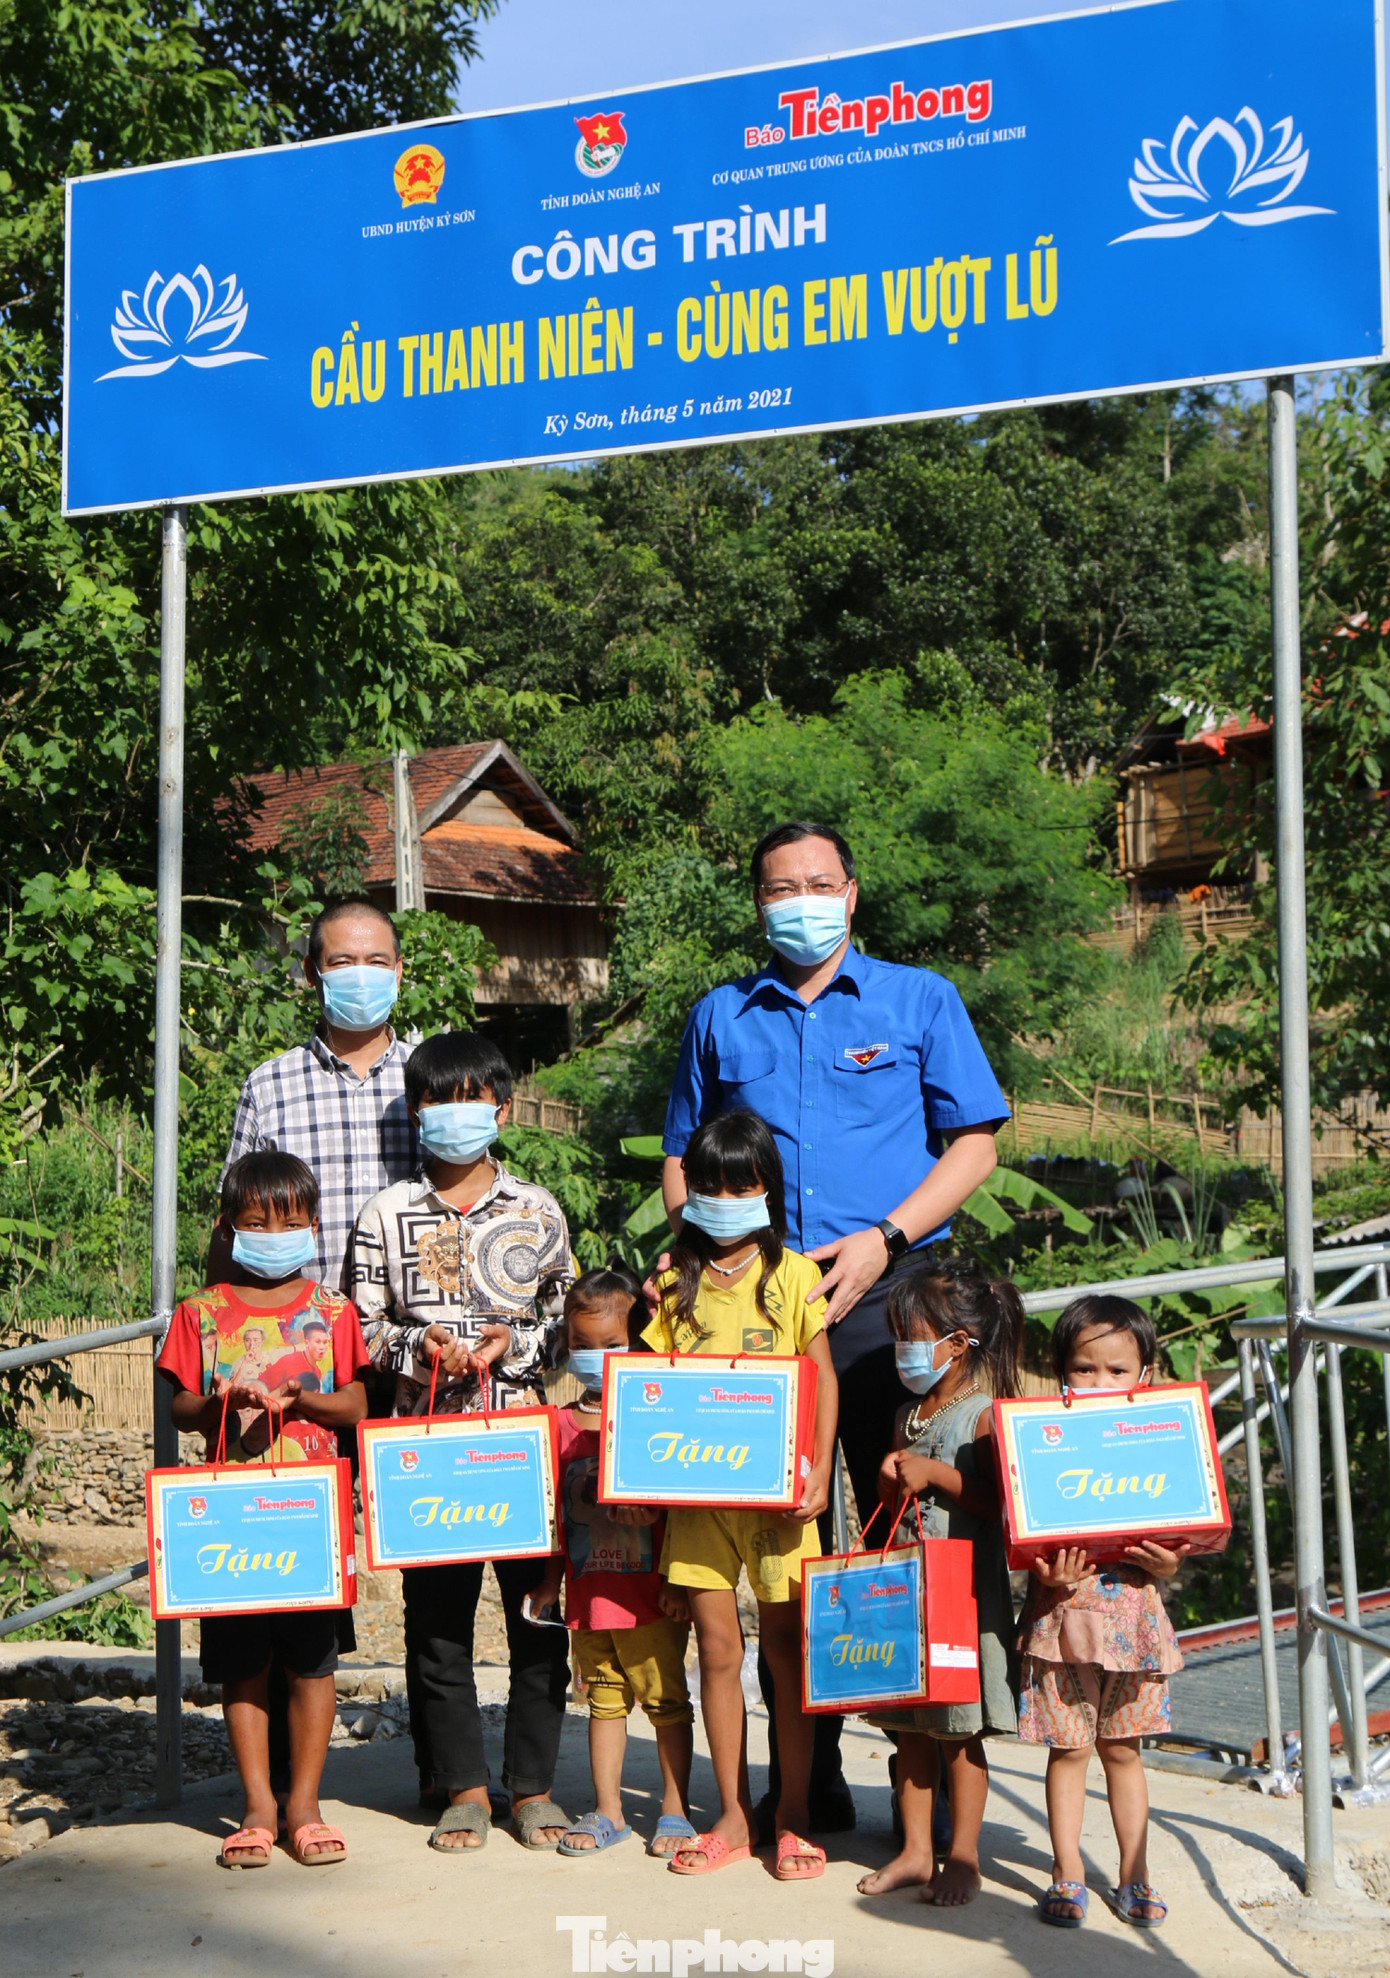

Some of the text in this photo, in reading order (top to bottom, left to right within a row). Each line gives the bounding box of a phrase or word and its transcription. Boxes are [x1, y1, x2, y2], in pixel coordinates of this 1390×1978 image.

[744, 123, 784, 148] Báo
[713, 126, 1025, 184] CƠ QUAN TRUNG ƯƠNG CỦA ĐOÀN TNCS HỒ CHÍ MINH
[572, 189, 604, 205] ĐOÀN
[608, 183, 641, 200] NGHỆ
[644, 183, 660, 195] AN
[362, 209, 475, 237] UBND HUYỆN KỲ SƠN
[511, 203, 826, 285] CÔNG TRÌNH
[311, 234, 1057, 408] CẦU THANH NIÊN - CÙNG EM VƯỢT LŨ
[574, 412, 613, 430] Sơn,
[621, 404, 678, 424] tháng
[682, 399, 695, 417] 5
[700, 395, 742, 415] năm
[748, 387, 792, 409] 2021
[303, 1435, 318, 1451] 10
[647, 1432, 752, 1470] Tặng
[1056, 1469, 1172, 1502] Tặng
[409, 1497, 513, 1530] Tặng
[196, 1544, 300, 1578] Tặng
[592, 1549, 622, 1559] LOVE
[830, 1634, 897, 1670] Tặng
